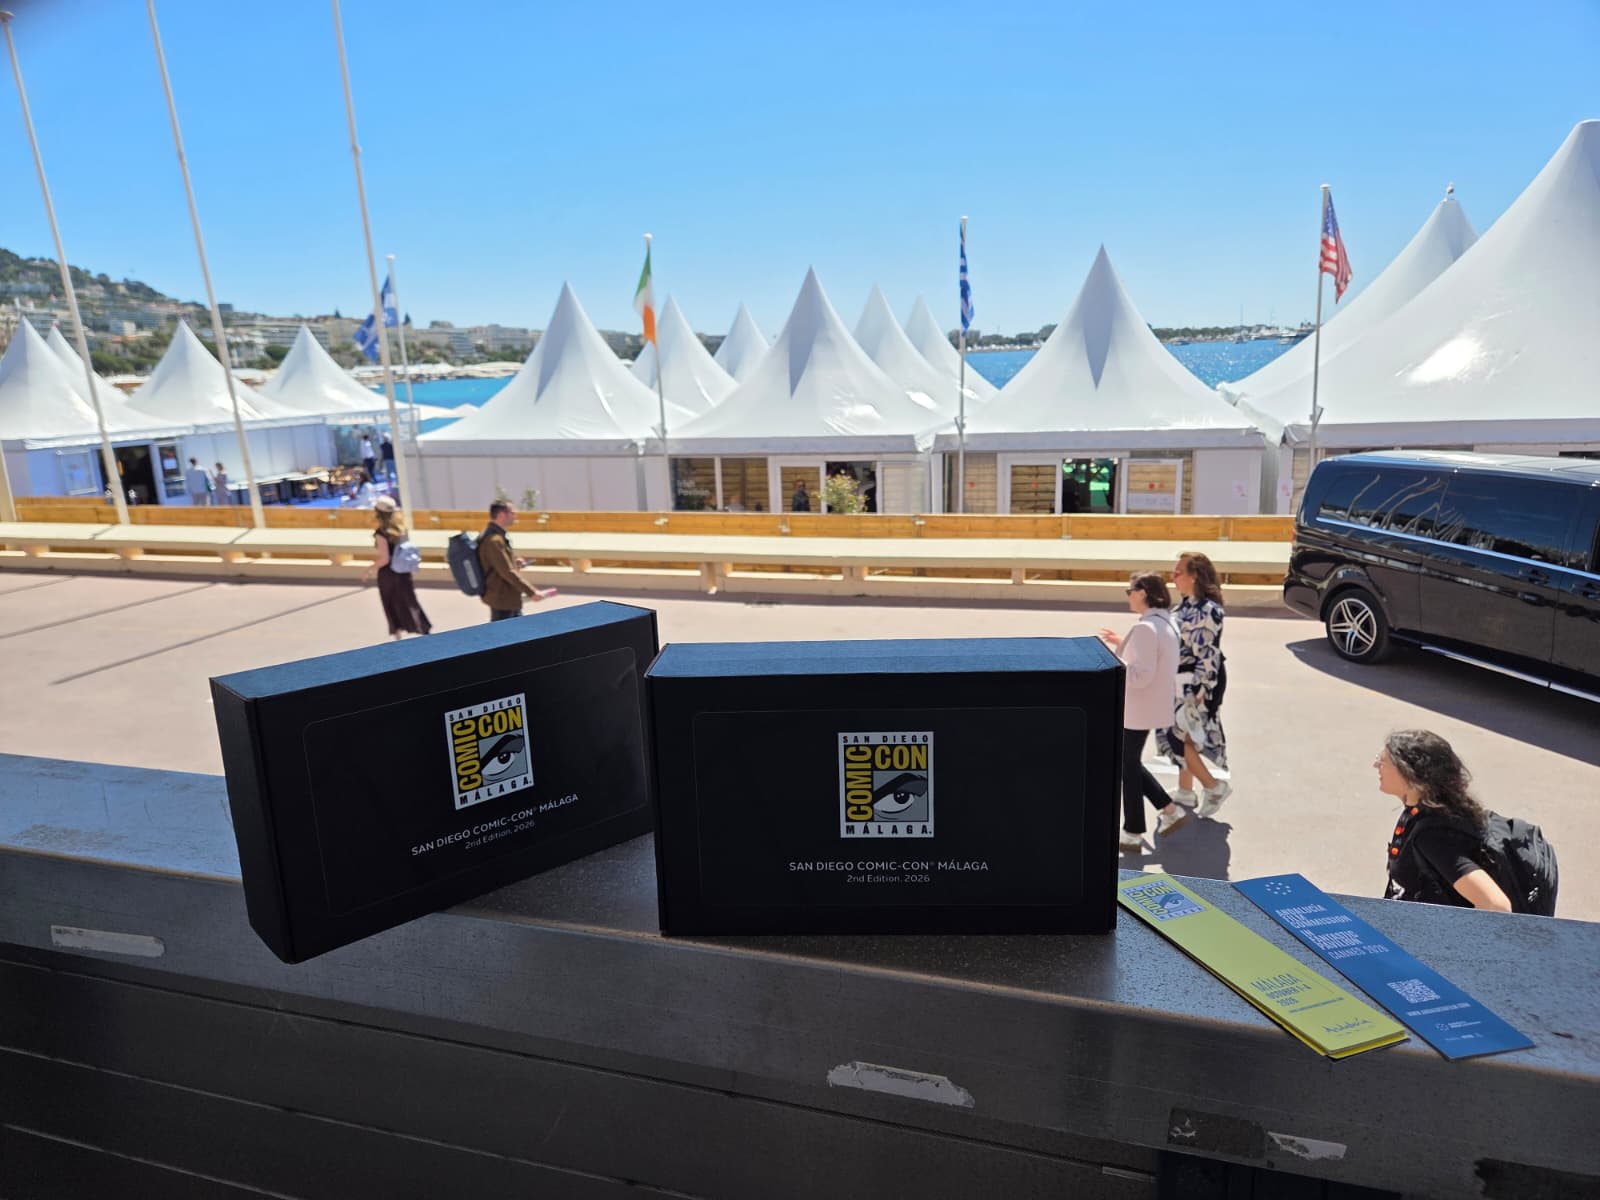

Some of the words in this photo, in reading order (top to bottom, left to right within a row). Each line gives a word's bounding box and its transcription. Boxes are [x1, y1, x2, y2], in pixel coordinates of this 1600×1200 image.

[449, 709, 473, 721] SAN
[483, 697, 521, 712] DIEGO
[478, 706, 522, 737] CON
[842, 735, 870, 744] SAN
[882, 734, 929, 744] DIEGO
[452, 719, 482, 791] COMIC
[874, 745, 927, 770] CON
[845, 745, 873, 821] COMIC
[411, 841, 435, 856] SAN
[436, 829, 471, 848] DIEGO
[539, 793, 579, 813] MÁLAGA
[465, 838, 482, 849] 2nd
[513, 819, 535, 833] 2026
[789, 861, 813, 871] SAN
[816, 861, 854, 871] DIEGO
[937, 858, 989, 871] MÁLAGA
[846, 874, 865, 883] 2nd
[904, 874, 930, 883] 2026
[1142, 885, 1175, 897] CON
[1250, 972, 1303, 993] MÁLAGA
